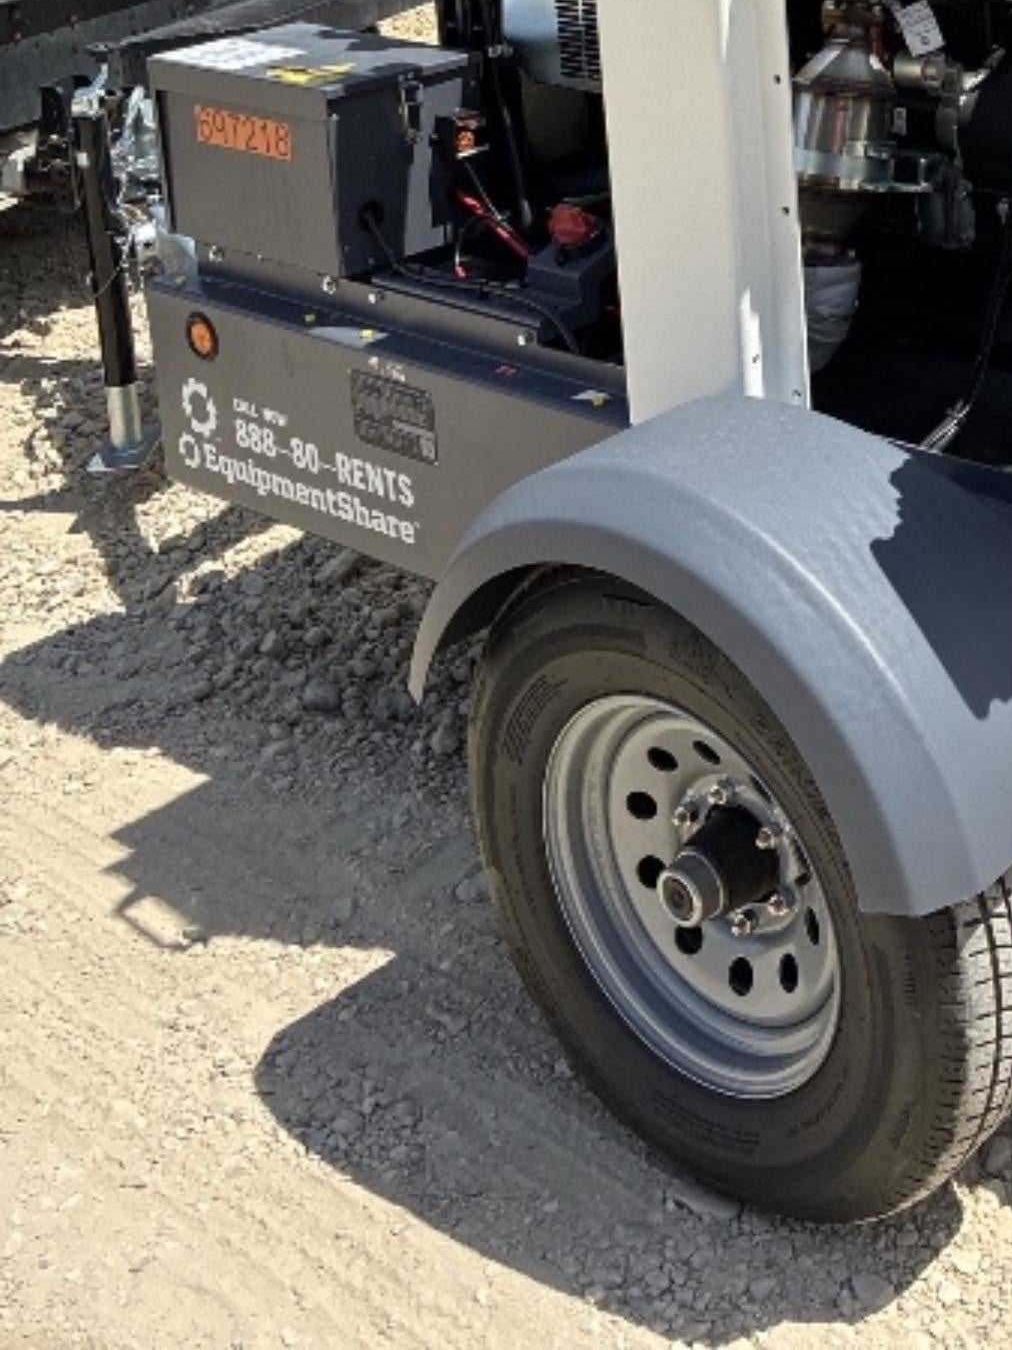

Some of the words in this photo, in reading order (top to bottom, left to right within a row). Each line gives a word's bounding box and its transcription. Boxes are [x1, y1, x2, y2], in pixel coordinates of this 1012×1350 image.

[200, 106, 289, 157] 697218
[203, 443, 415, 544] EquipmentShare
[234, 419, 415, 507] 888-80-RENTS
